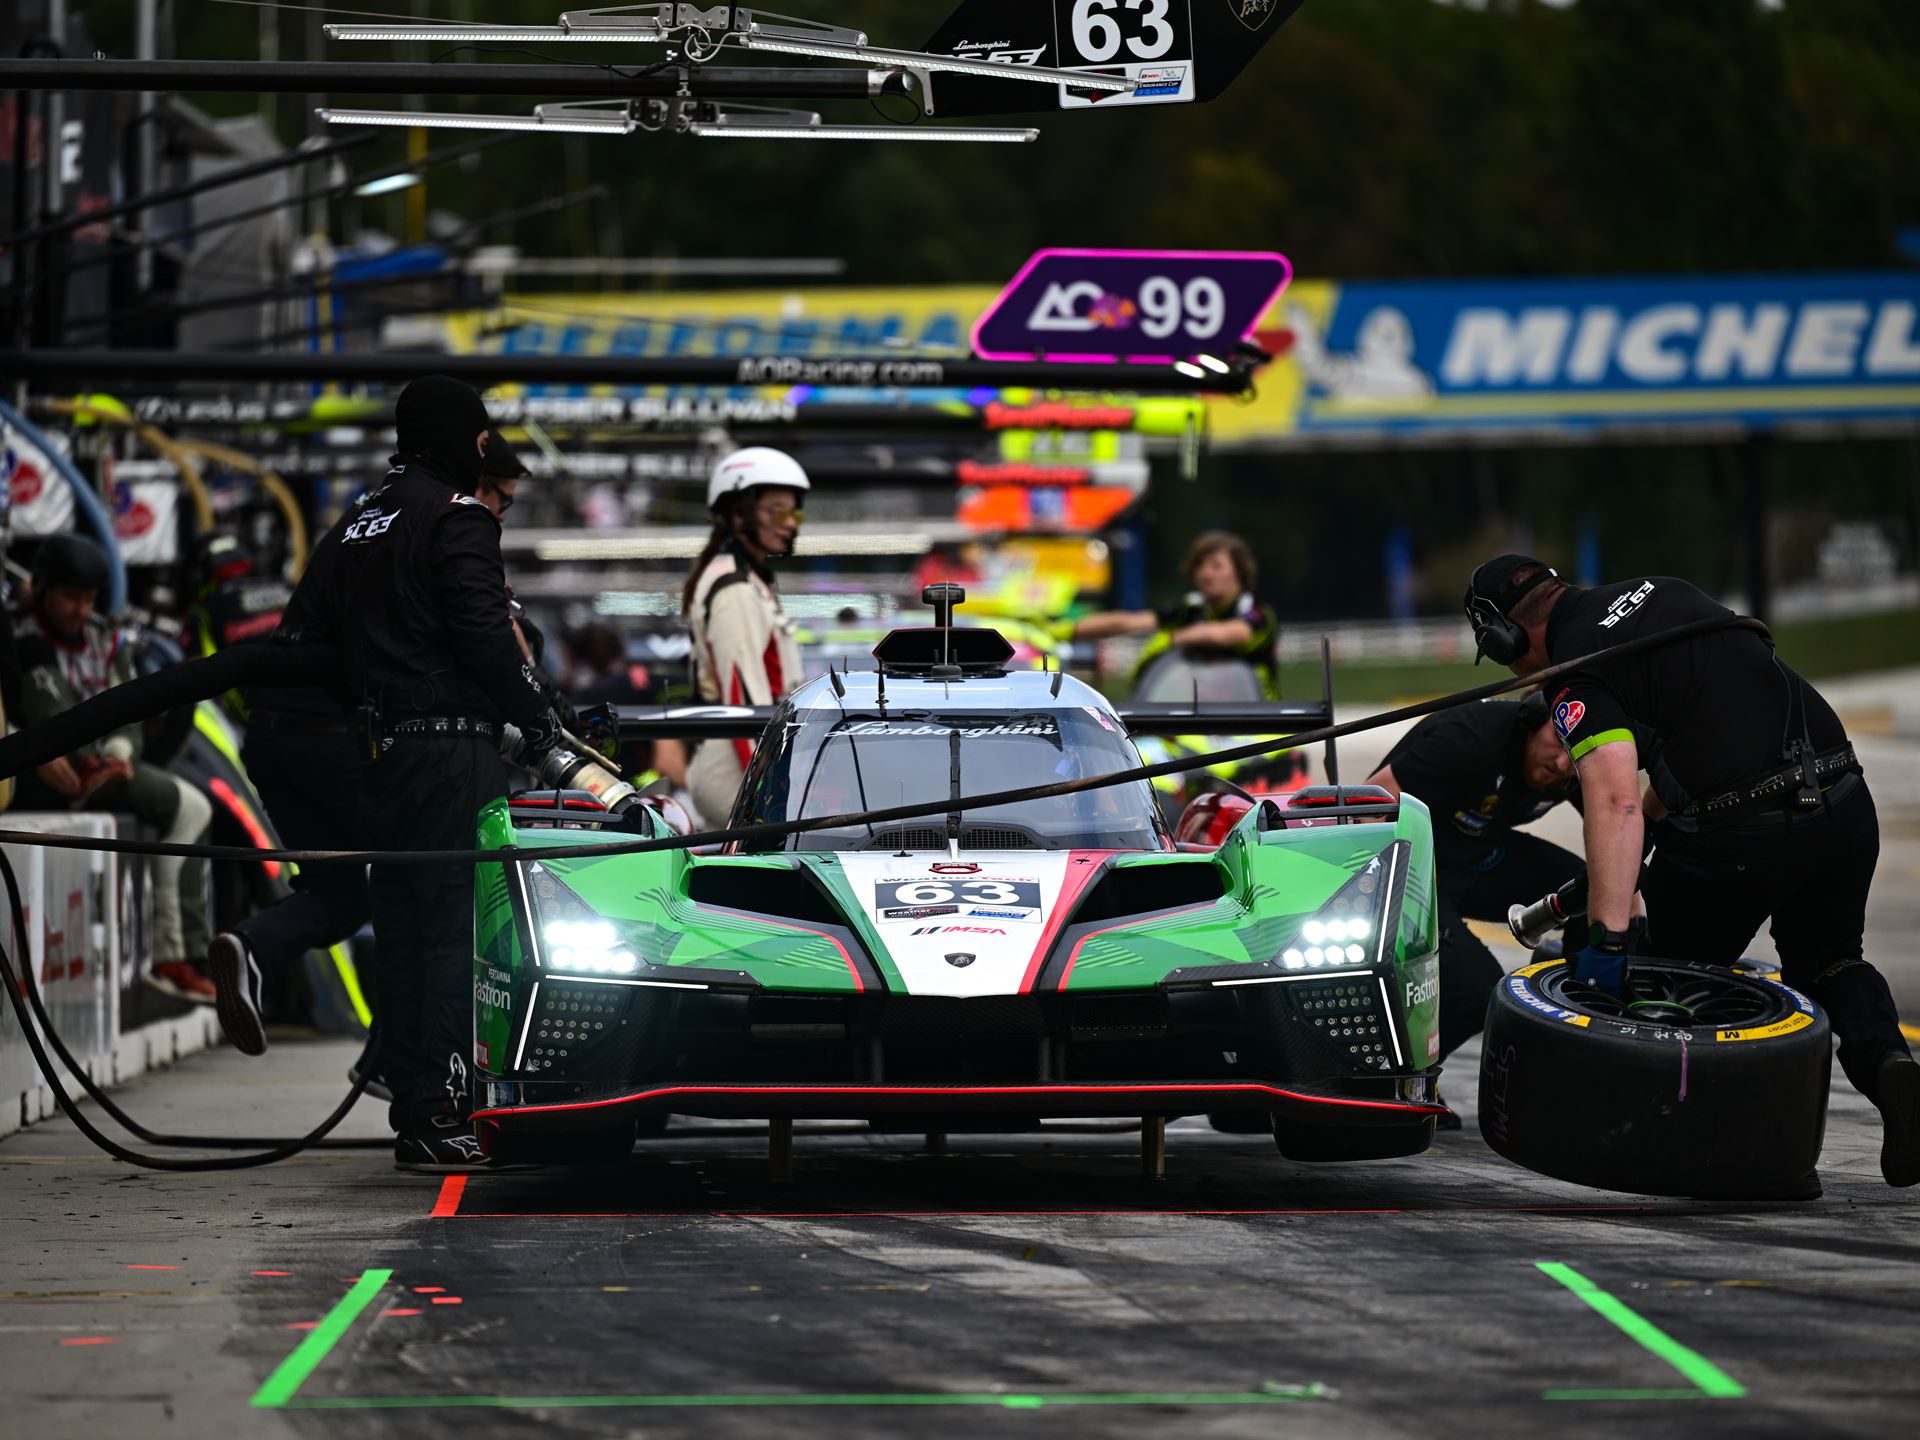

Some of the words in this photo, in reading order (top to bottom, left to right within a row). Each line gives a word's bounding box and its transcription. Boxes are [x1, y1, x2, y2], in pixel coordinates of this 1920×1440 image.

[1072, 0, 1174, 62] 63
[953, 40, 1011, 51] Lamborghini
[1138, 276, 1225, 339] 99
[1440, 302, 1920, 386] MICHEL
[737, 358, 944, 384] AORacing.com
[341, 508, 402, 544] SC63
[1598, 580, 1655, 629] SC63
[824, 721, 1059, 738] Lamborghini
[895, 881, 1020, 905] 63
[942, 926, 1007, 936] IMSA
[488, 967, 511, 984] PERTAMINA
[473, 974, 511, 1010] Fastron
[1510, 978, 1560, 1013] MICHELIN
[1724, 1031, 1740, 1039] M
[1767, 1023, 1791, 1033] SPORT
